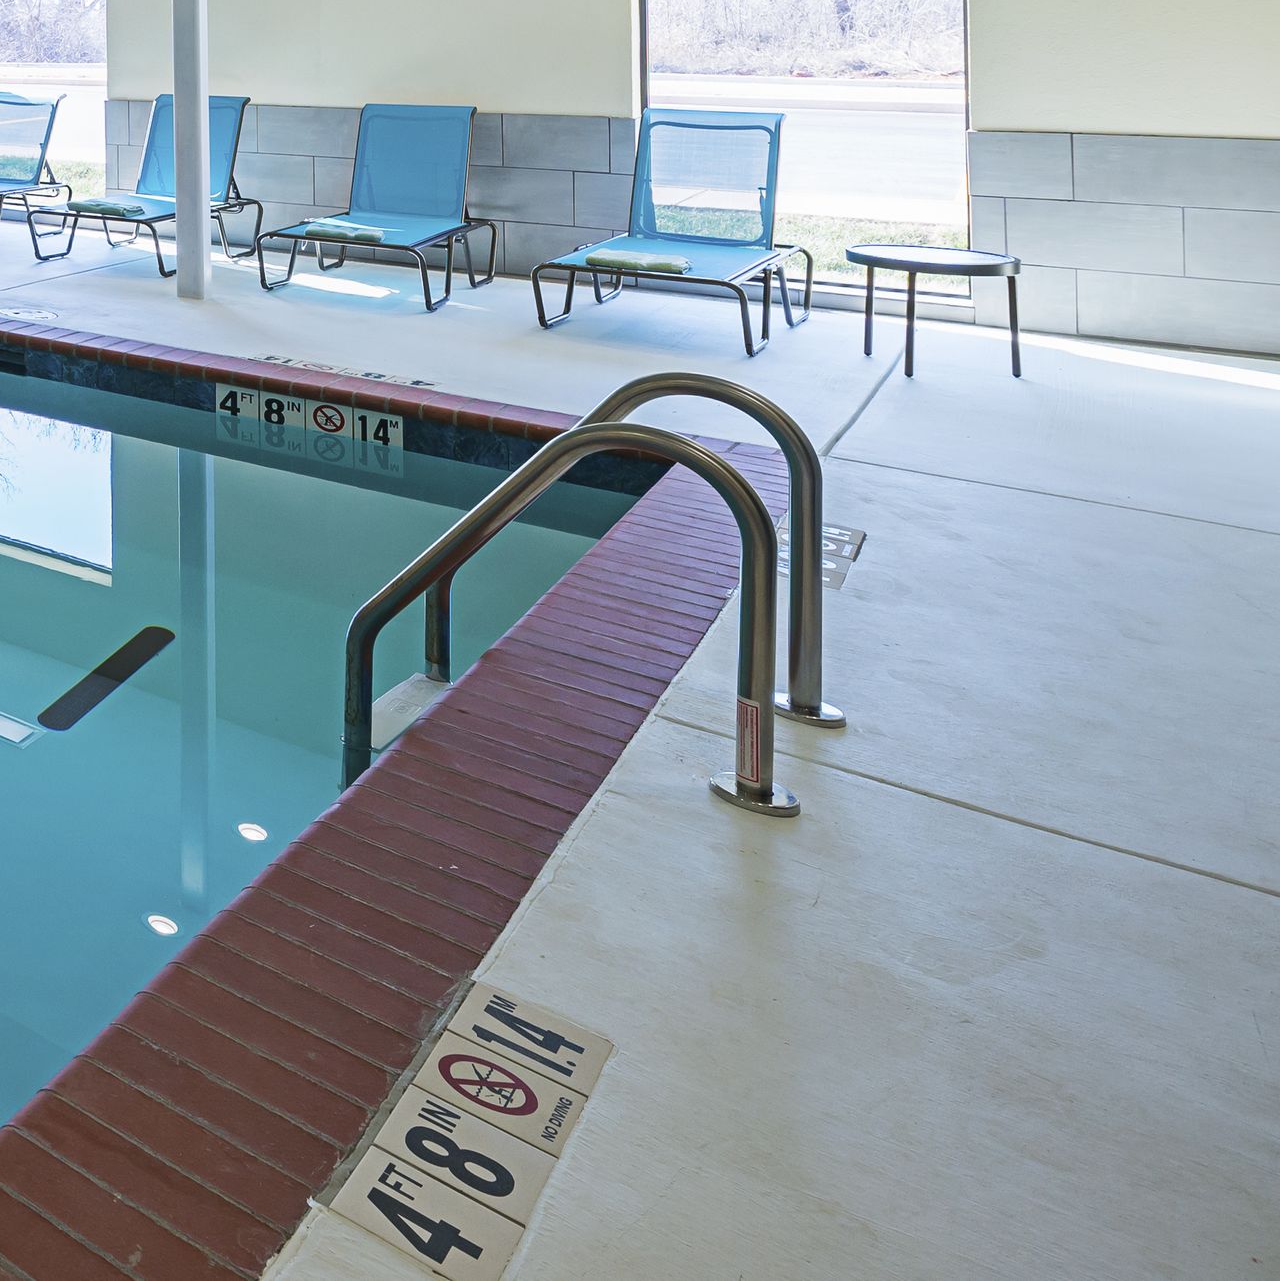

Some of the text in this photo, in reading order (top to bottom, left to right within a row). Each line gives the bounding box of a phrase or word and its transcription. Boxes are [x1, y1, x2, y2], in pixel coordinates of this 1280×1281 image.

[220, 390, 240, 416] 4
[241, 392, 255, 404] FT
[264, 398, 285, 425] 8
[287, 401, 301, 413] IN
[489, 994, 518, 1013] M
[417, 1099, 461, 1133] IN
[541, 1097, 572, 1142] NO DIVING
[405, 1125, 515, 1197] 8
[378, 1162, 423, 1201] FT
[367, 1186, 483, 1264] 4
